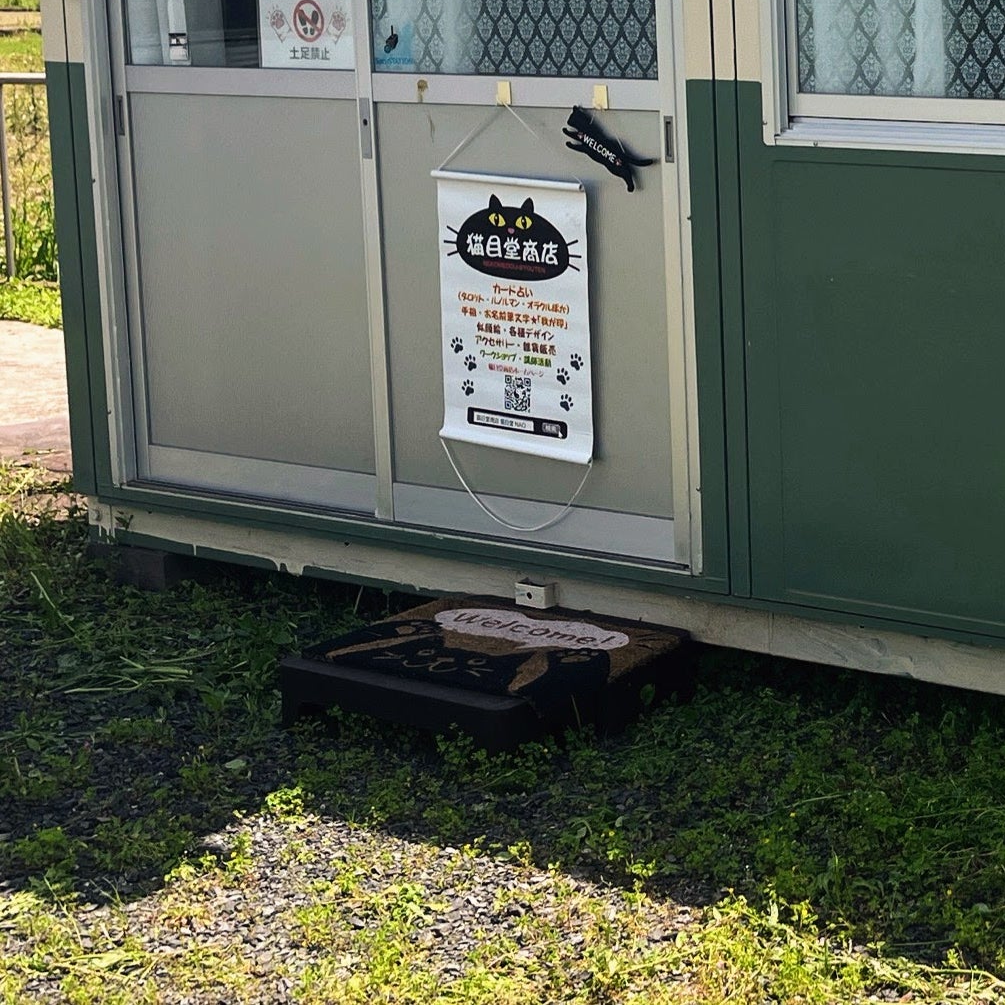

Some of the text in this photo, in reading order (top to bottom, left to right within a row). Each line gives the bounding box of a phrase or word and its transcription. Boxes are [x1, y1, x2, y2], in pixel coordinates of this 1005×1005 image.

[289, 45, 331, 61] 土足禁止
[582, 133, 617, 163] WELCOME
[466, 232, 559, 265] 猫目堂商店
[492, 282, 534, 298] カード占い
[454, 612, 622, 644] Welcome!
